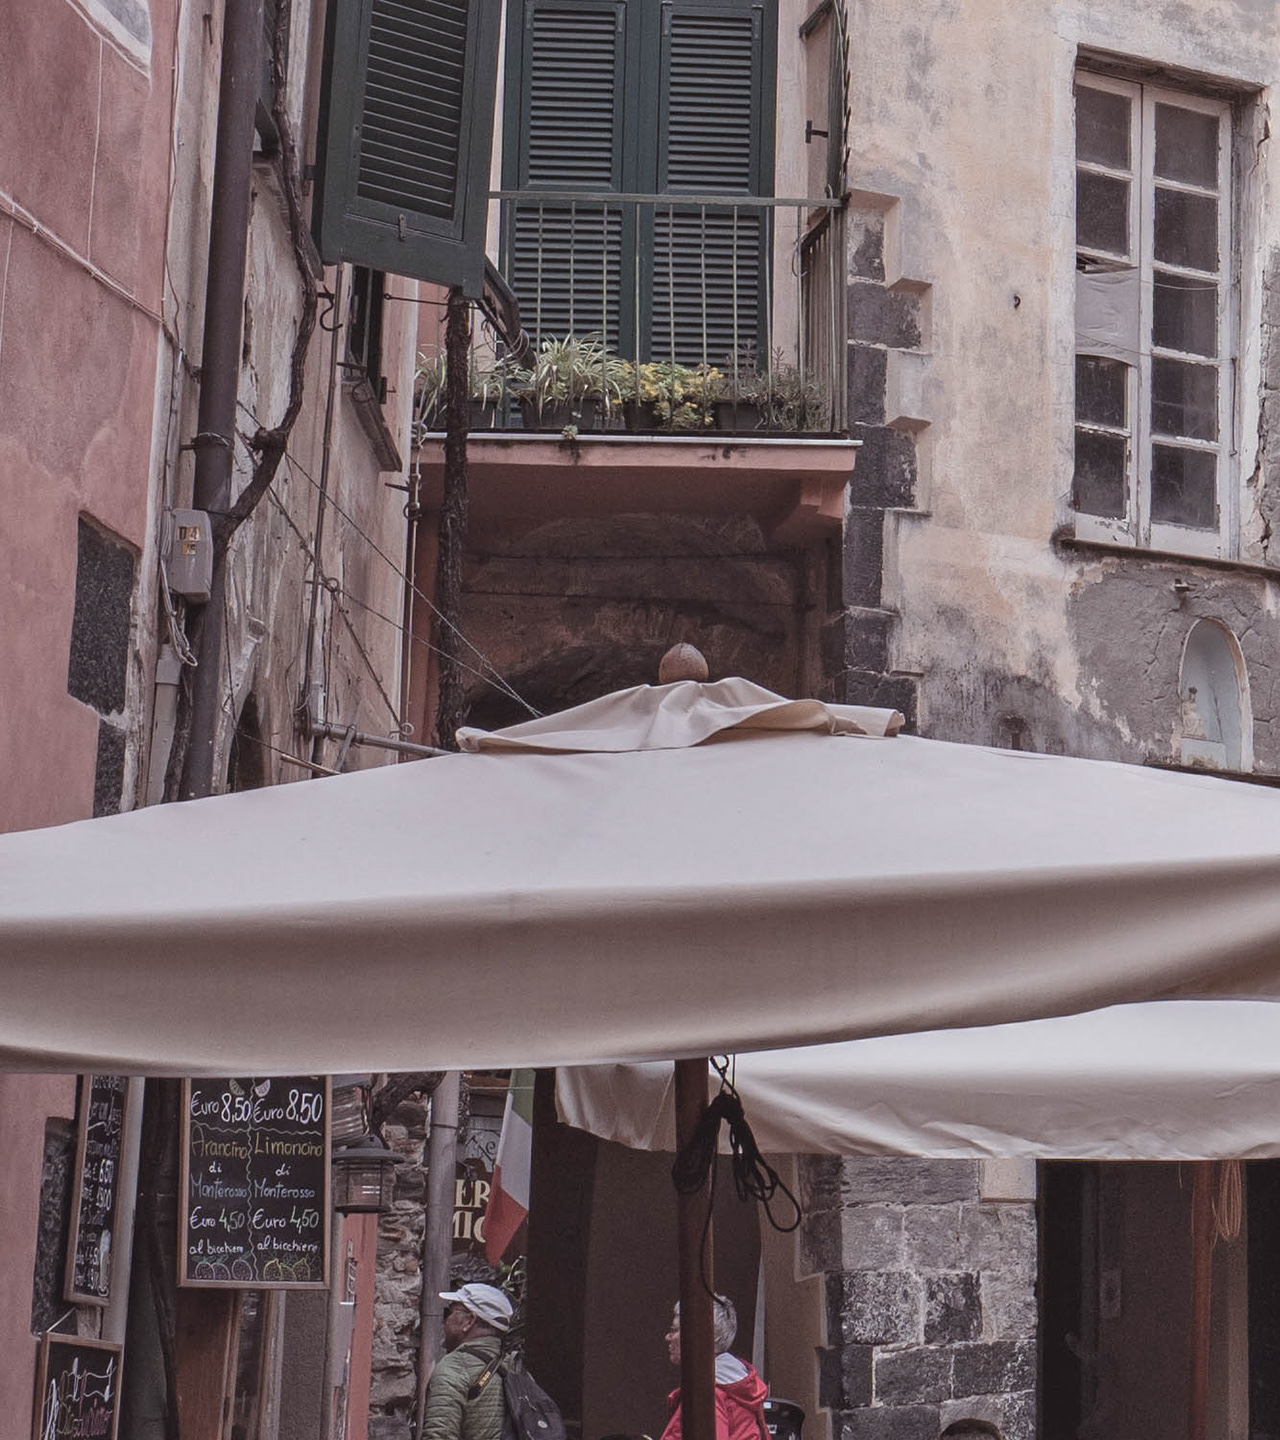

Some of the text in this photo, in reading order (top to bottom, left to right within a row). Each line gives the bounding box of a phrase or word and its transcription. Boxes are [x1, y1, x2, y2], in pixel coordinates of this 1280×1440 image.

[254, 1132, 324, 1157] Limoncino
[209, 1161, 222, 1173] di
[275, 1163, 290, 1176] di
[190, 1172, 248, 1200] Monterosso
[254, 1178, 315, 1199] Monterosso
